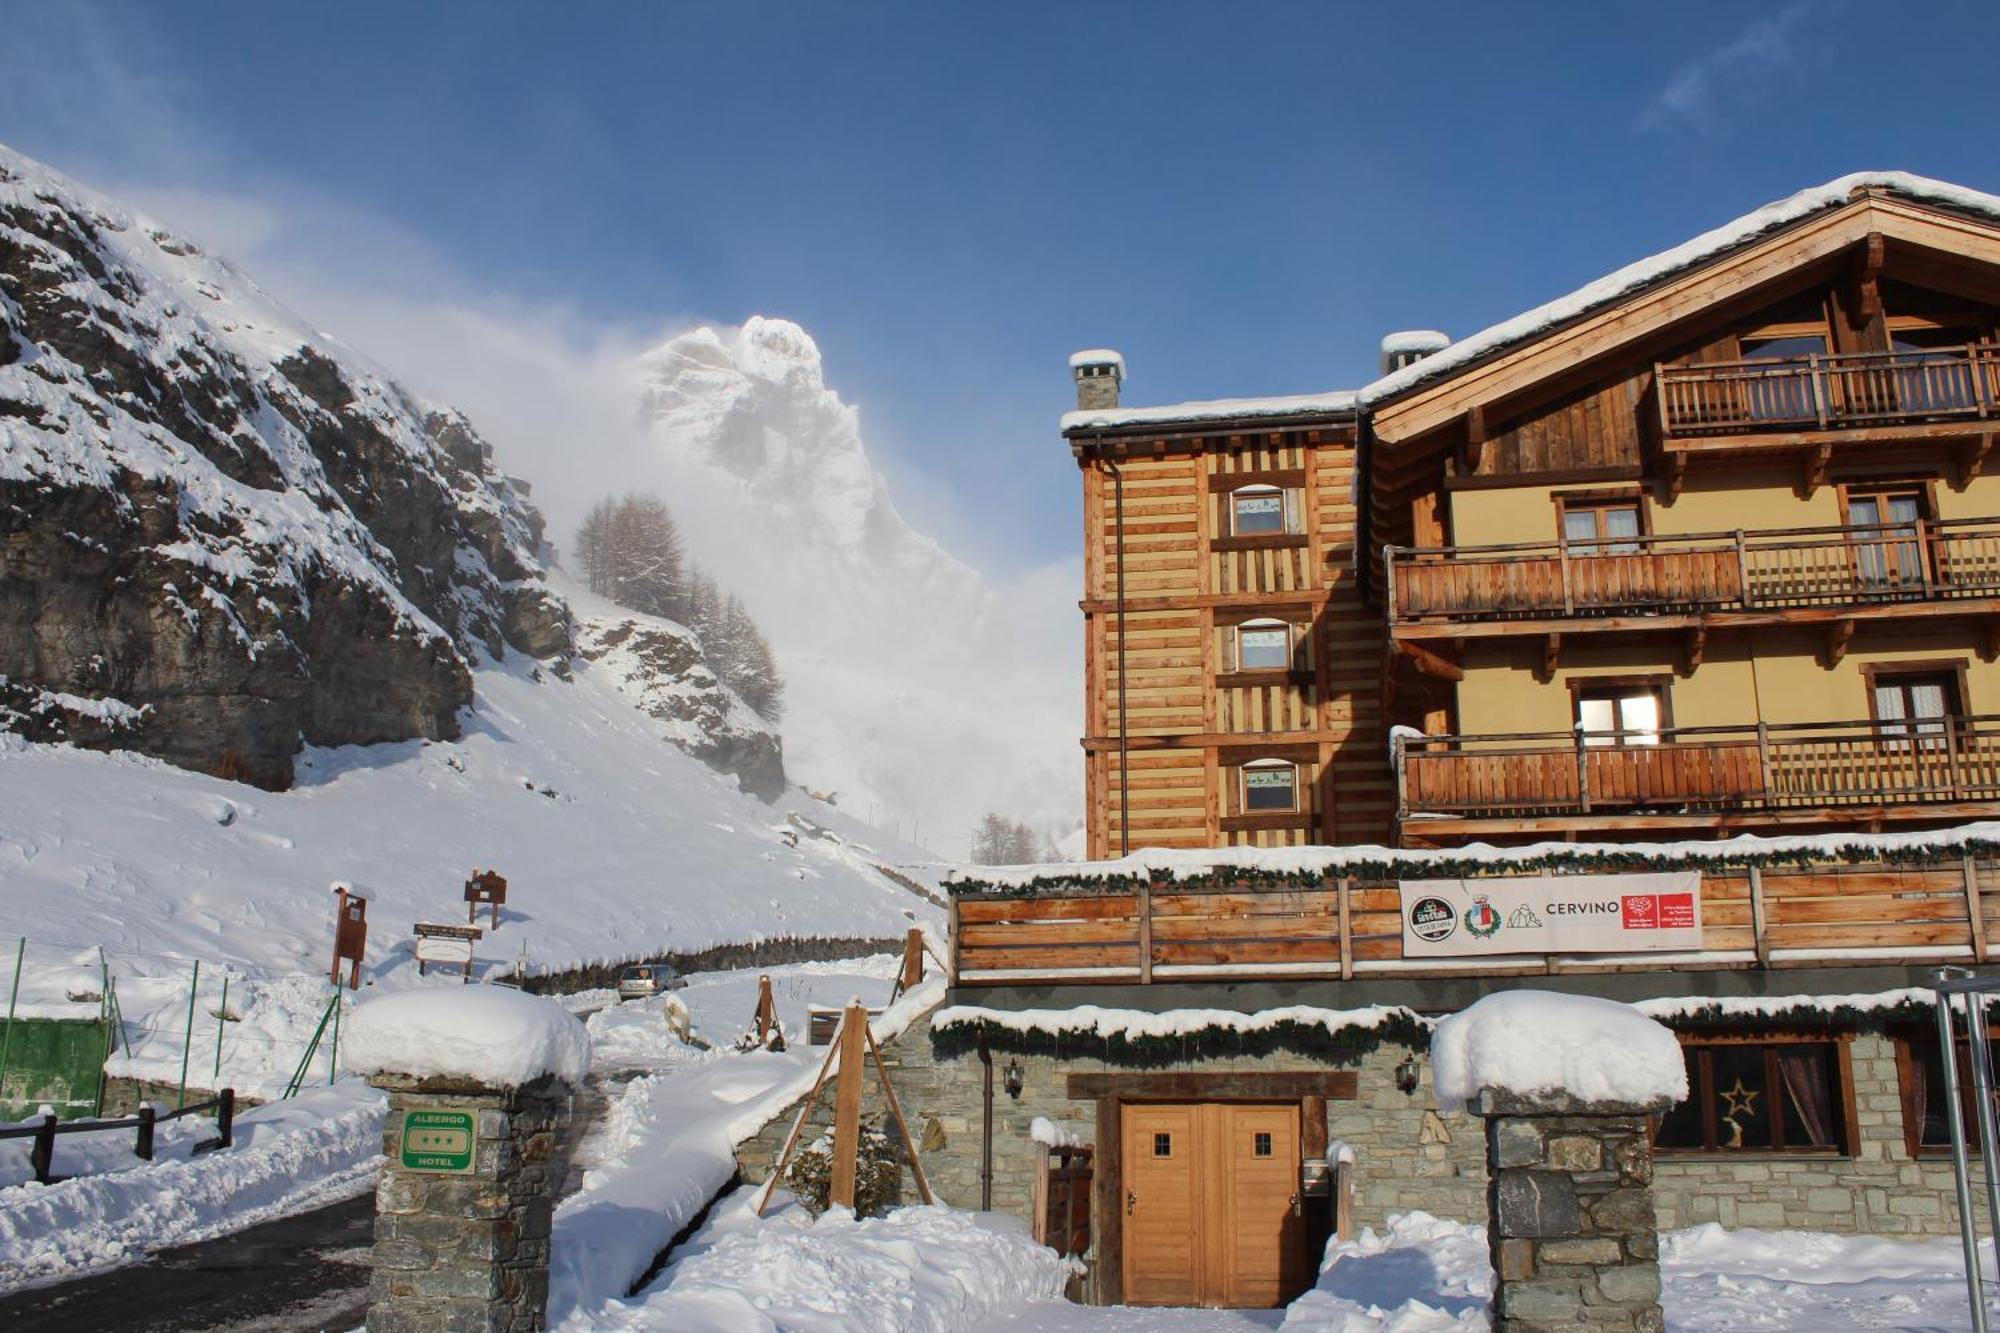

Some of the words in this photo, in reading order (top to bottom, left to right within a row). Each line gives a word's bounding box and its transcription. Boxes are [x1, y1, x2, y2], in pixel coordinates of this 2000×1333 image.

[1546, 901, 1619, 915] CERVINO
[414, 1114, 466, 1124] ALBERGO
[418, 1157, 454, 1167] HOTEL
